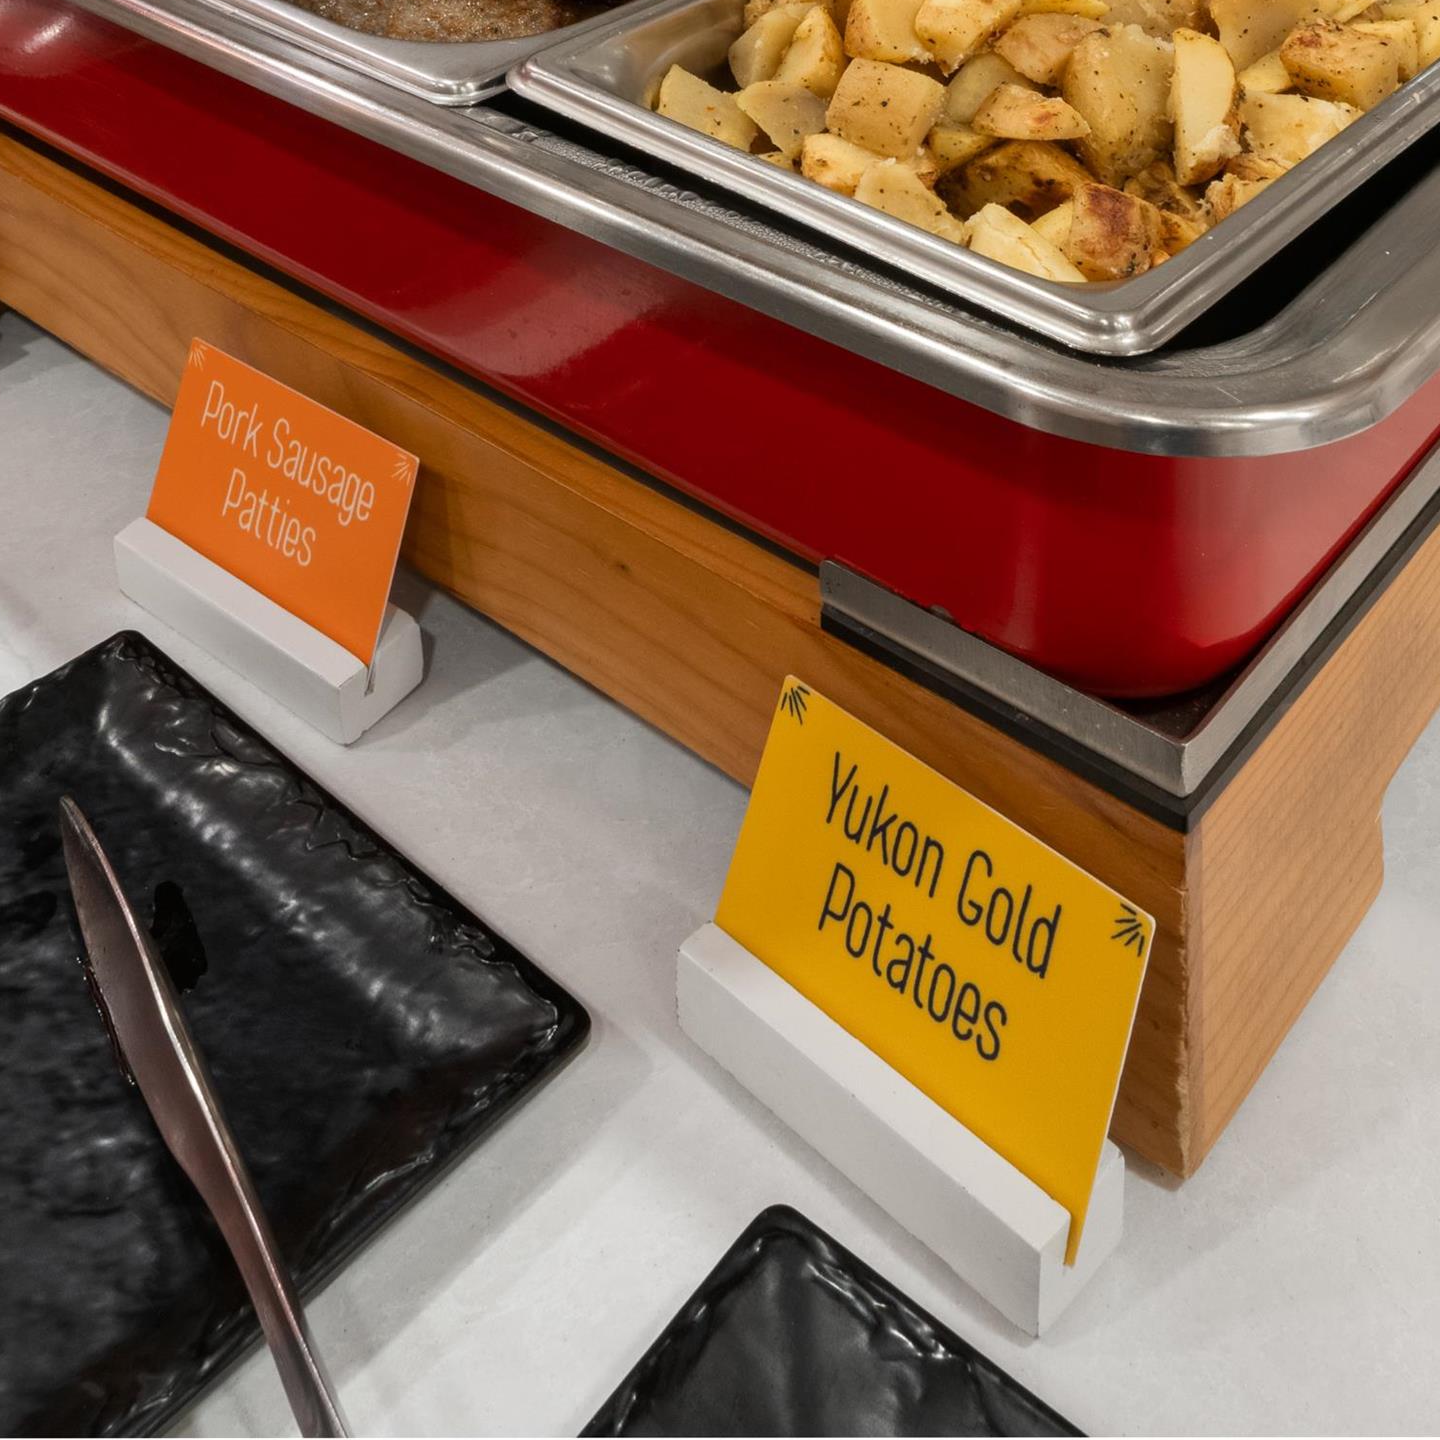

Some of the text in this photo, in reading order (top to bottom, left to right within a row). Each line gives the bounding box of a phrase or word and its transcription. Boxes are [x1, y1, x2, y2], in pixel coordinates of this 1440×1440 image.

[201, 380, 376, 527] Pork Sausage
[221, 468, 317, 567] Patties
[825, 751, 1063, 979] Yukon Gold
[818, 862, 1008, 1062] Potatoes
